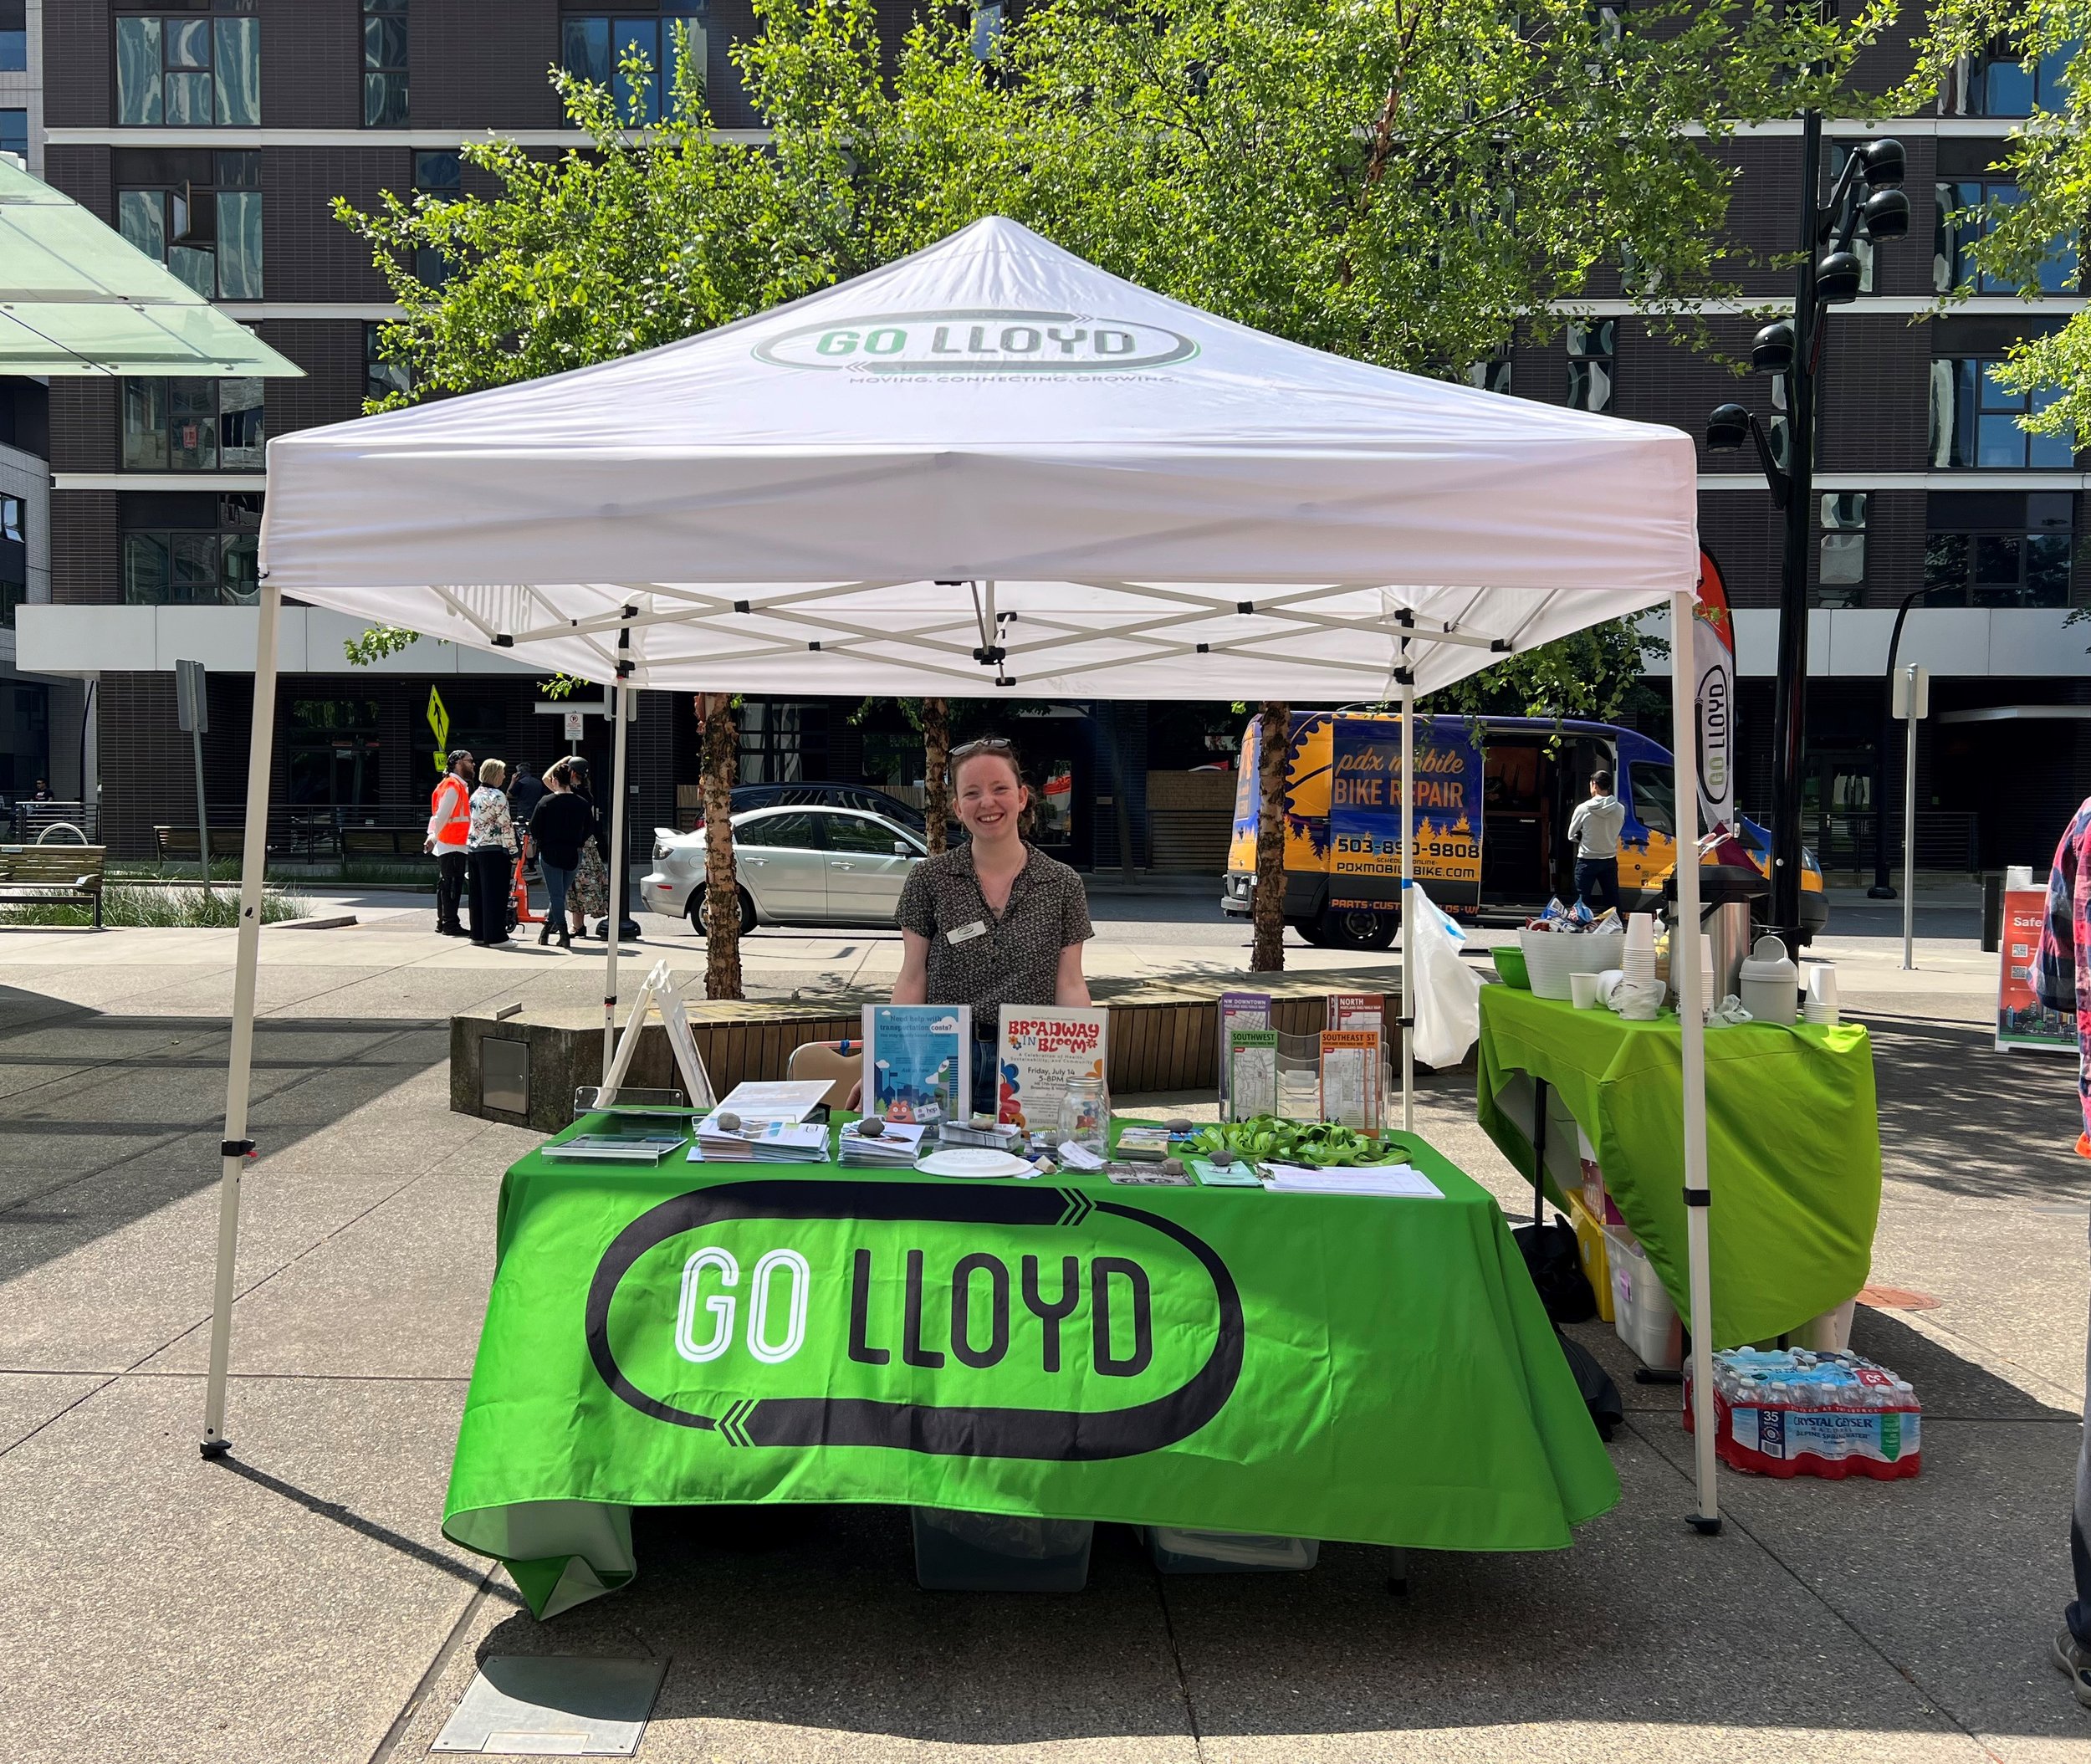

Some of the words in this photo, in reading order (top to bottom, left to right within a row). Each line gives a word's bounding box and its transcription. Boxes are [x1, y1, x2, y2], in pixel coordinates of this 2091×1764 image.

[815, 327, 907, 356] GO
[930, 326, 1137, 356] LLOYD
[937, 376, 1072, 384] CONNECTING.
[1708, 683, 1725, 749] LLOYD
[1335, 747, 1384, 777] pdx
[1388, 748, 1464, 775] mbile
[1709, 756, 1725, 785] GO
[1334, 778, 1383, 805] BIKE
[1337, 862, 1475, 878] PDXMOBILBIKE.COM
[1332, 898, 1368, 908] PARTS
[2013, 917, 2042, 927] Safe
[909, 1015, 926, 1023] help
[880, 1024, 929, 1032] transportation
[1008, 1020, 1100, 1039] BROADWAY
[1022, 1035, 1036, 1046] IN
[1037, 1037, 1086, 1054] BLOOM
[1027, 1066, 1051, 1076] Friday,
[1052, 1068, 1066, 1076] July
[926, 1106, 938, 1115] hop
[674, 1246, 810, 1365] GO
[847, 1249, 1153, 1378] LLOYD
[1763, 1410, 1779, 1423] 35
[1793, 1416, 1834, 1428] CRYSTAL
